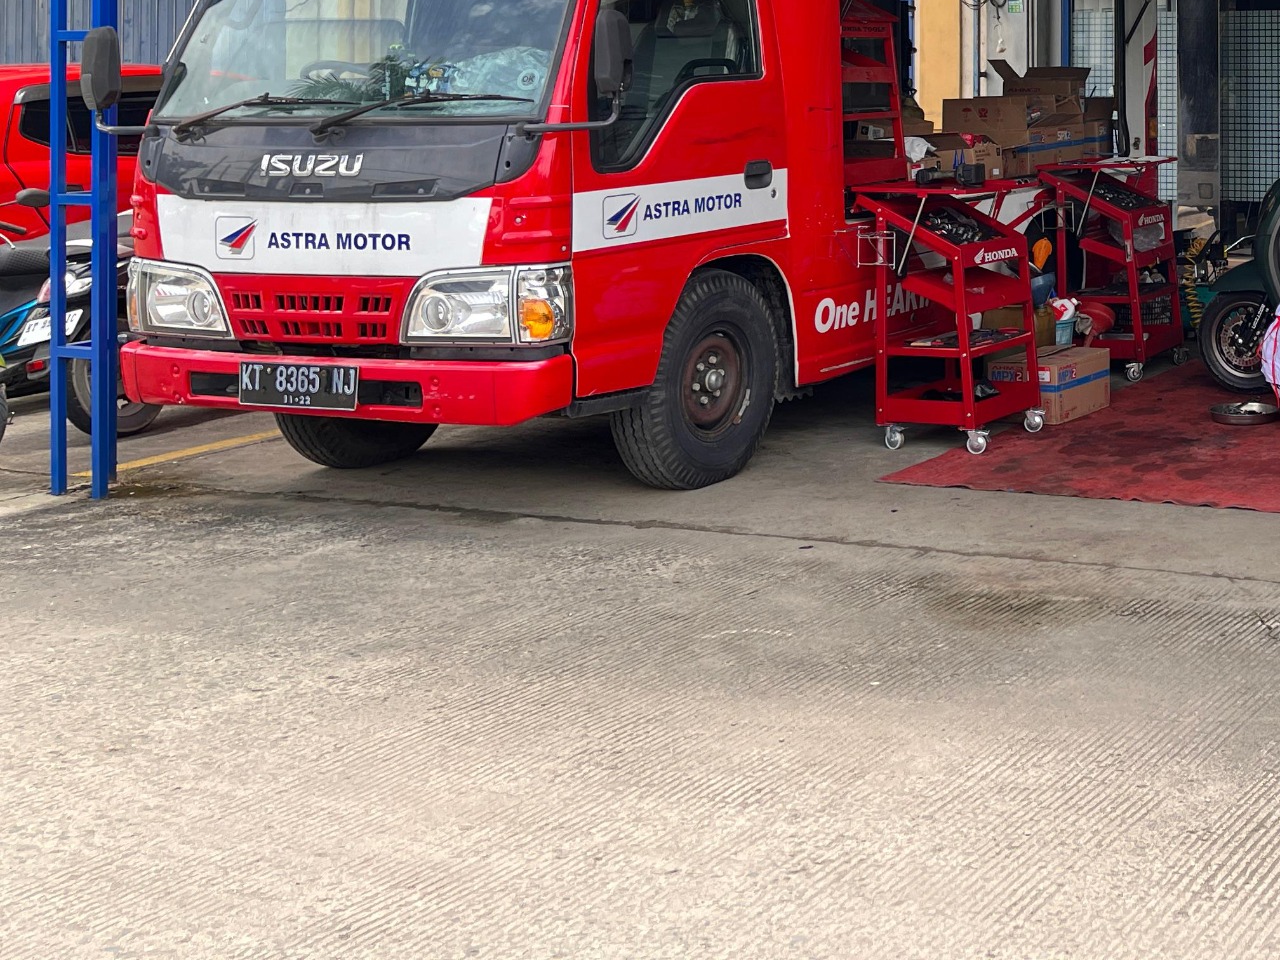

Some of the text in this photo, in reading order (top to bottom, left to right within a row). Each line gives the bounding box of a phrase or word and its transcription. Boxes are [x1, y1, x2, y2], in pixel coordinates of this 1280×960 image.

[260, 153, 364, 177] ISUZU
[643, 192, 742, 222] ASTRA MOTOR
[1144, 214, 1164, 224] HONDA
[268, 232, 411, 251] ASTRA MOTOR
[984, 248, 1018, 262] HONDA
[814, 297, 860, 334] One
[242, 364, 356, 396] KT 8365 NJ
